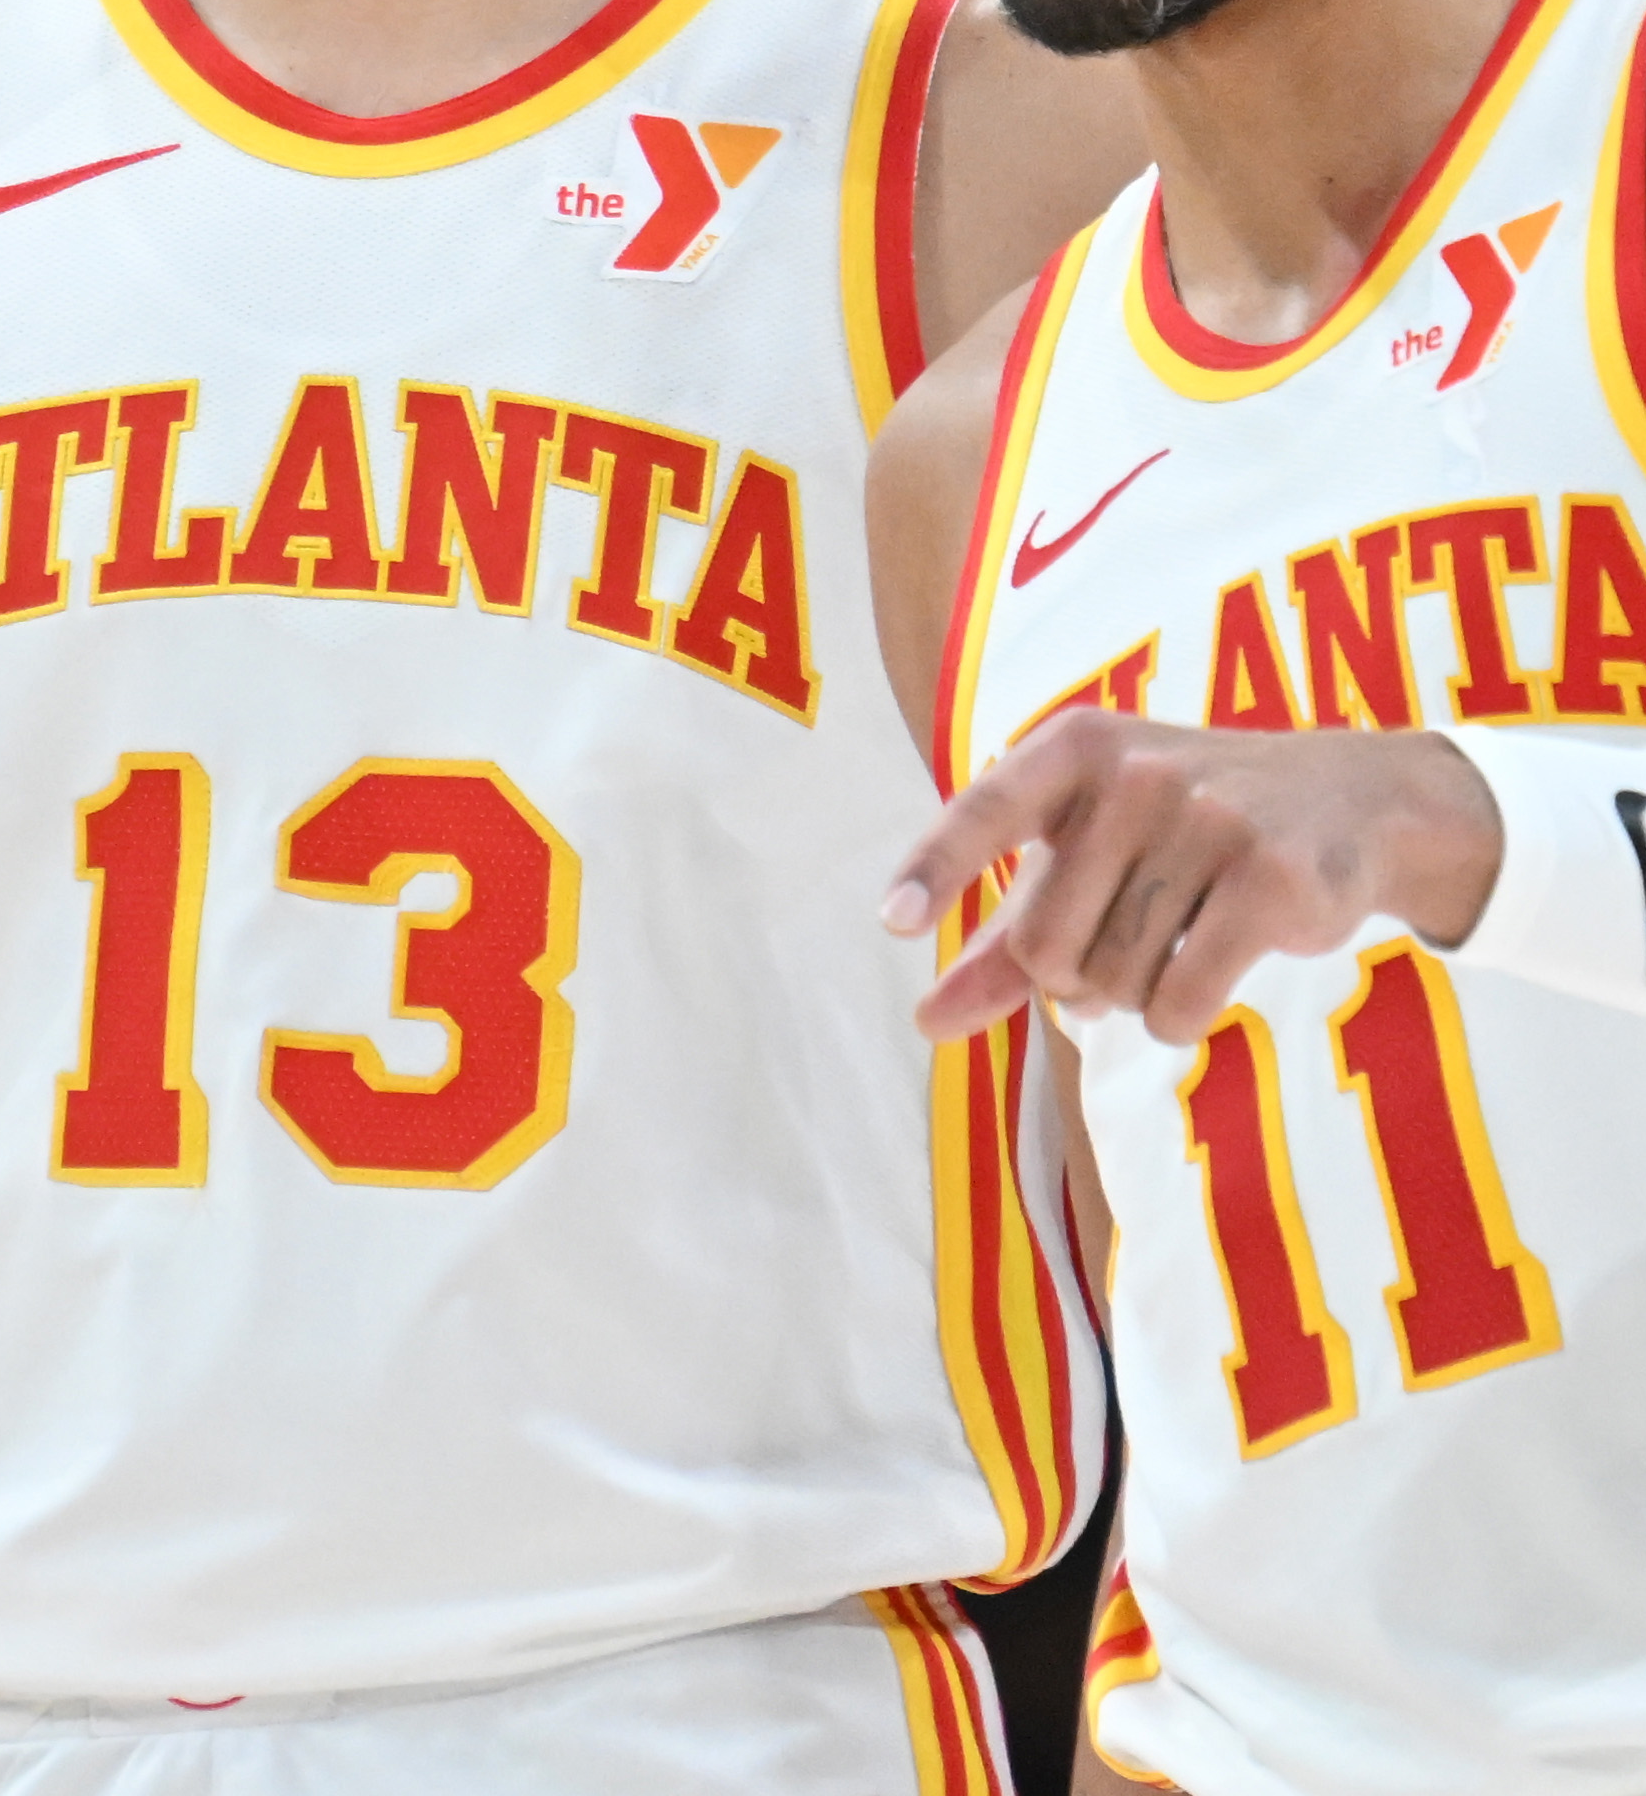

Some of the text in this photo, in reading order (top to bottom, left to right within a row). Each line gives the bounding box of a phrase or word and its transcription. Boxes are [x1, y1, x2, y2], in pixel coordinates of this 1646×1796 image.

[556, 182, 625, 218] the
[678, 233, 720, 271] YMCA
[1391, 325, 1444, 367] the
[48, 751, 582, 1191] 13
[1175, 934, 1564, 1462] 11
